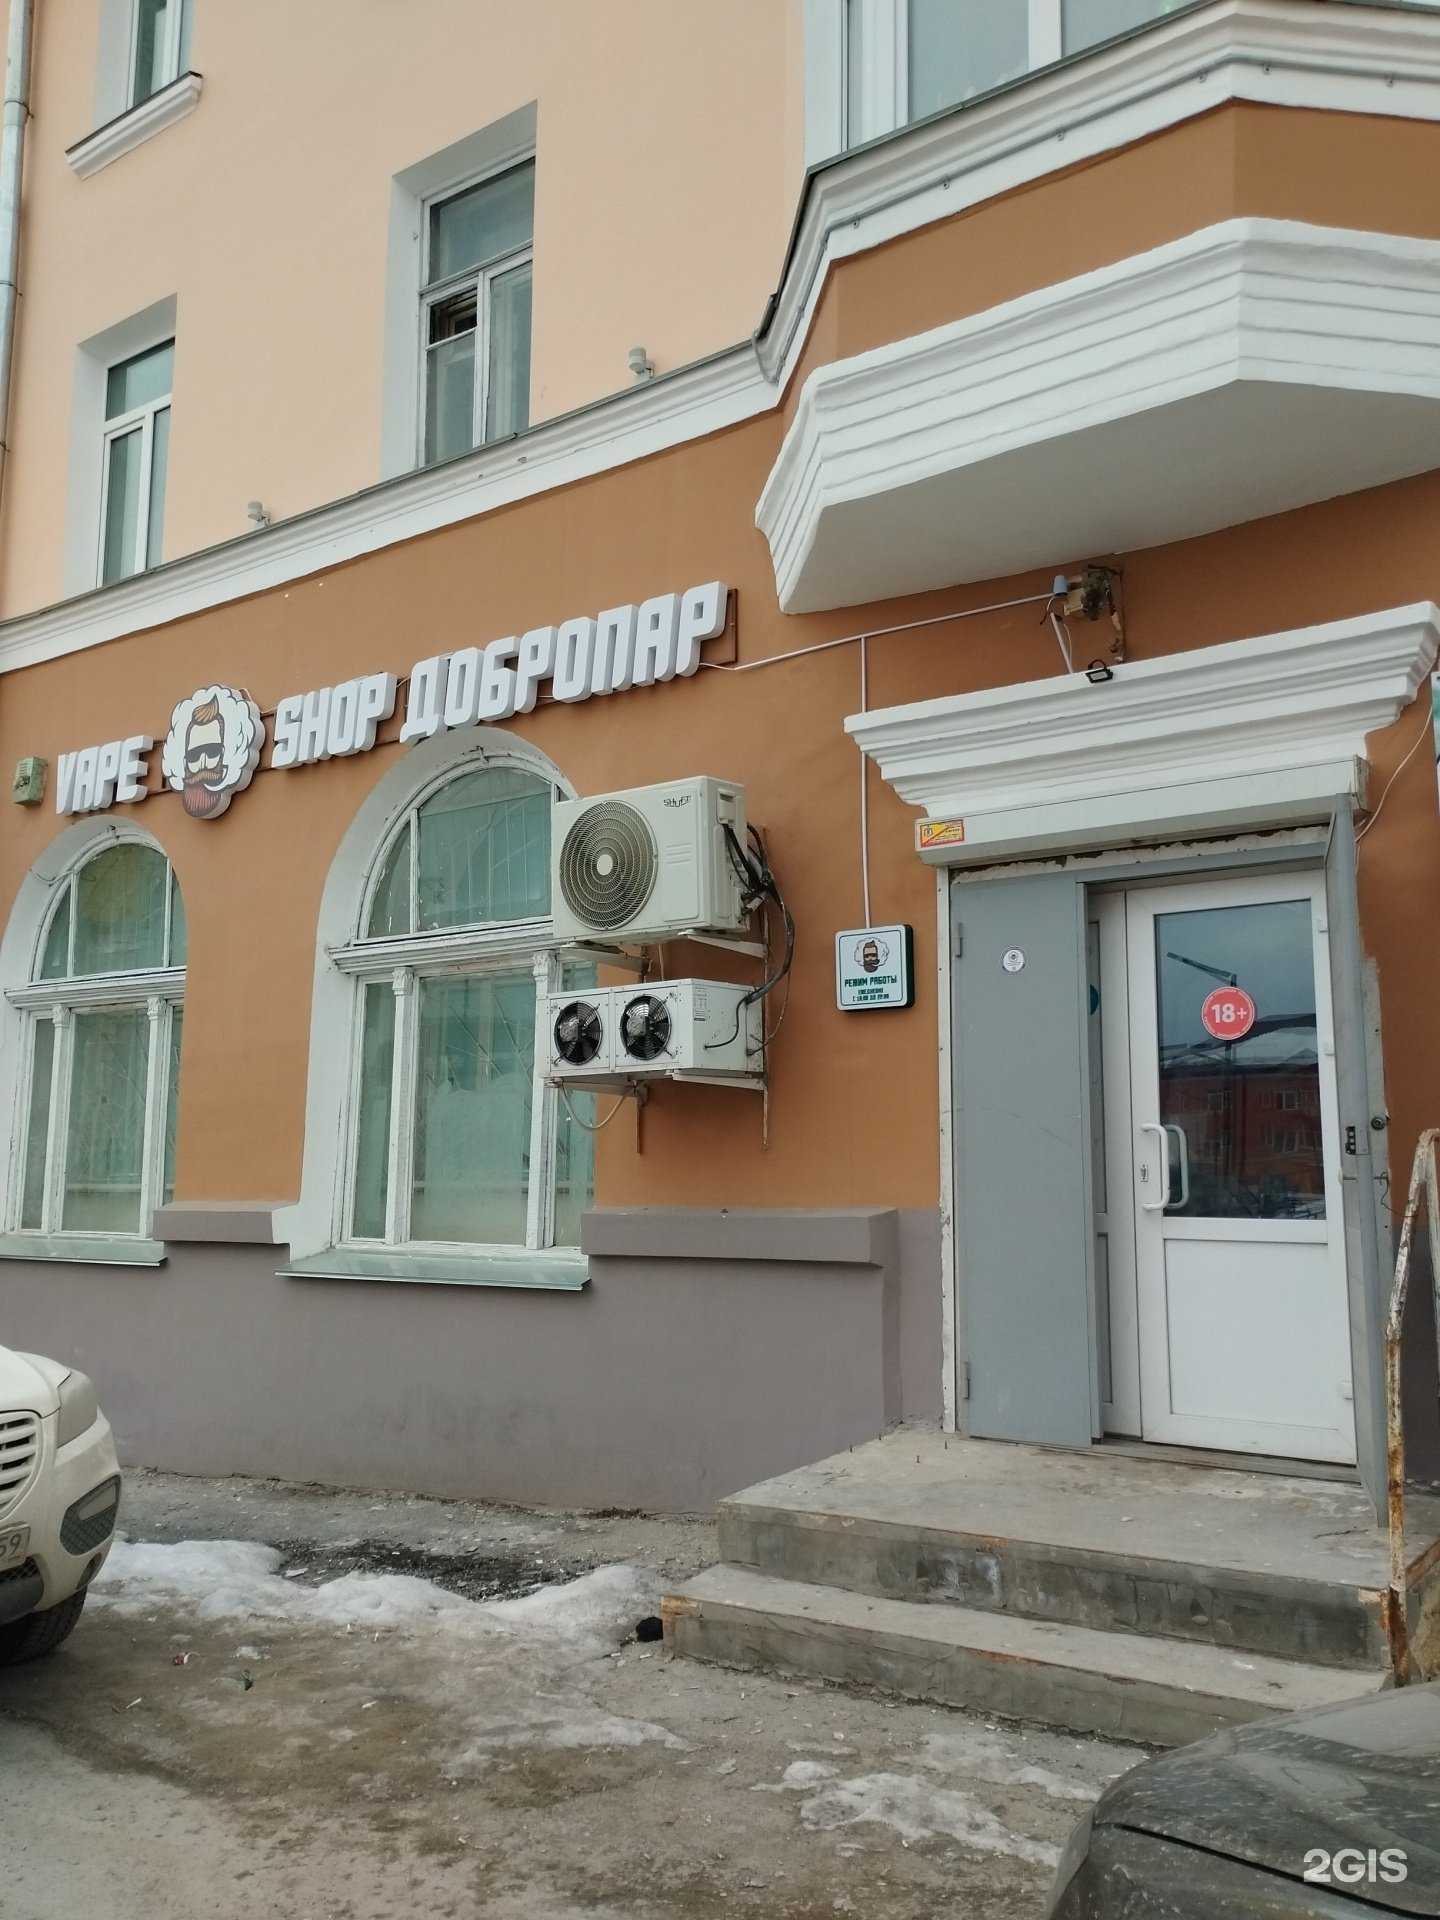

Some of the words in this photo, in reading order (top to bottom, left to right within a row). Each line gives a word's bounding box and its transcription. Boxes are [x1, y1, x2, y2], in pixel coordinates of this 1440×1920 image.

[56, 735, 151, 815] VAPE
[271, 672, 397, 769] SHOP
[400, 581, 727, 743] ДОБРОПАР
[869, 975, 897, 986] РАБОТЫ
[1211, 1003, 1248, 1024] 18+
